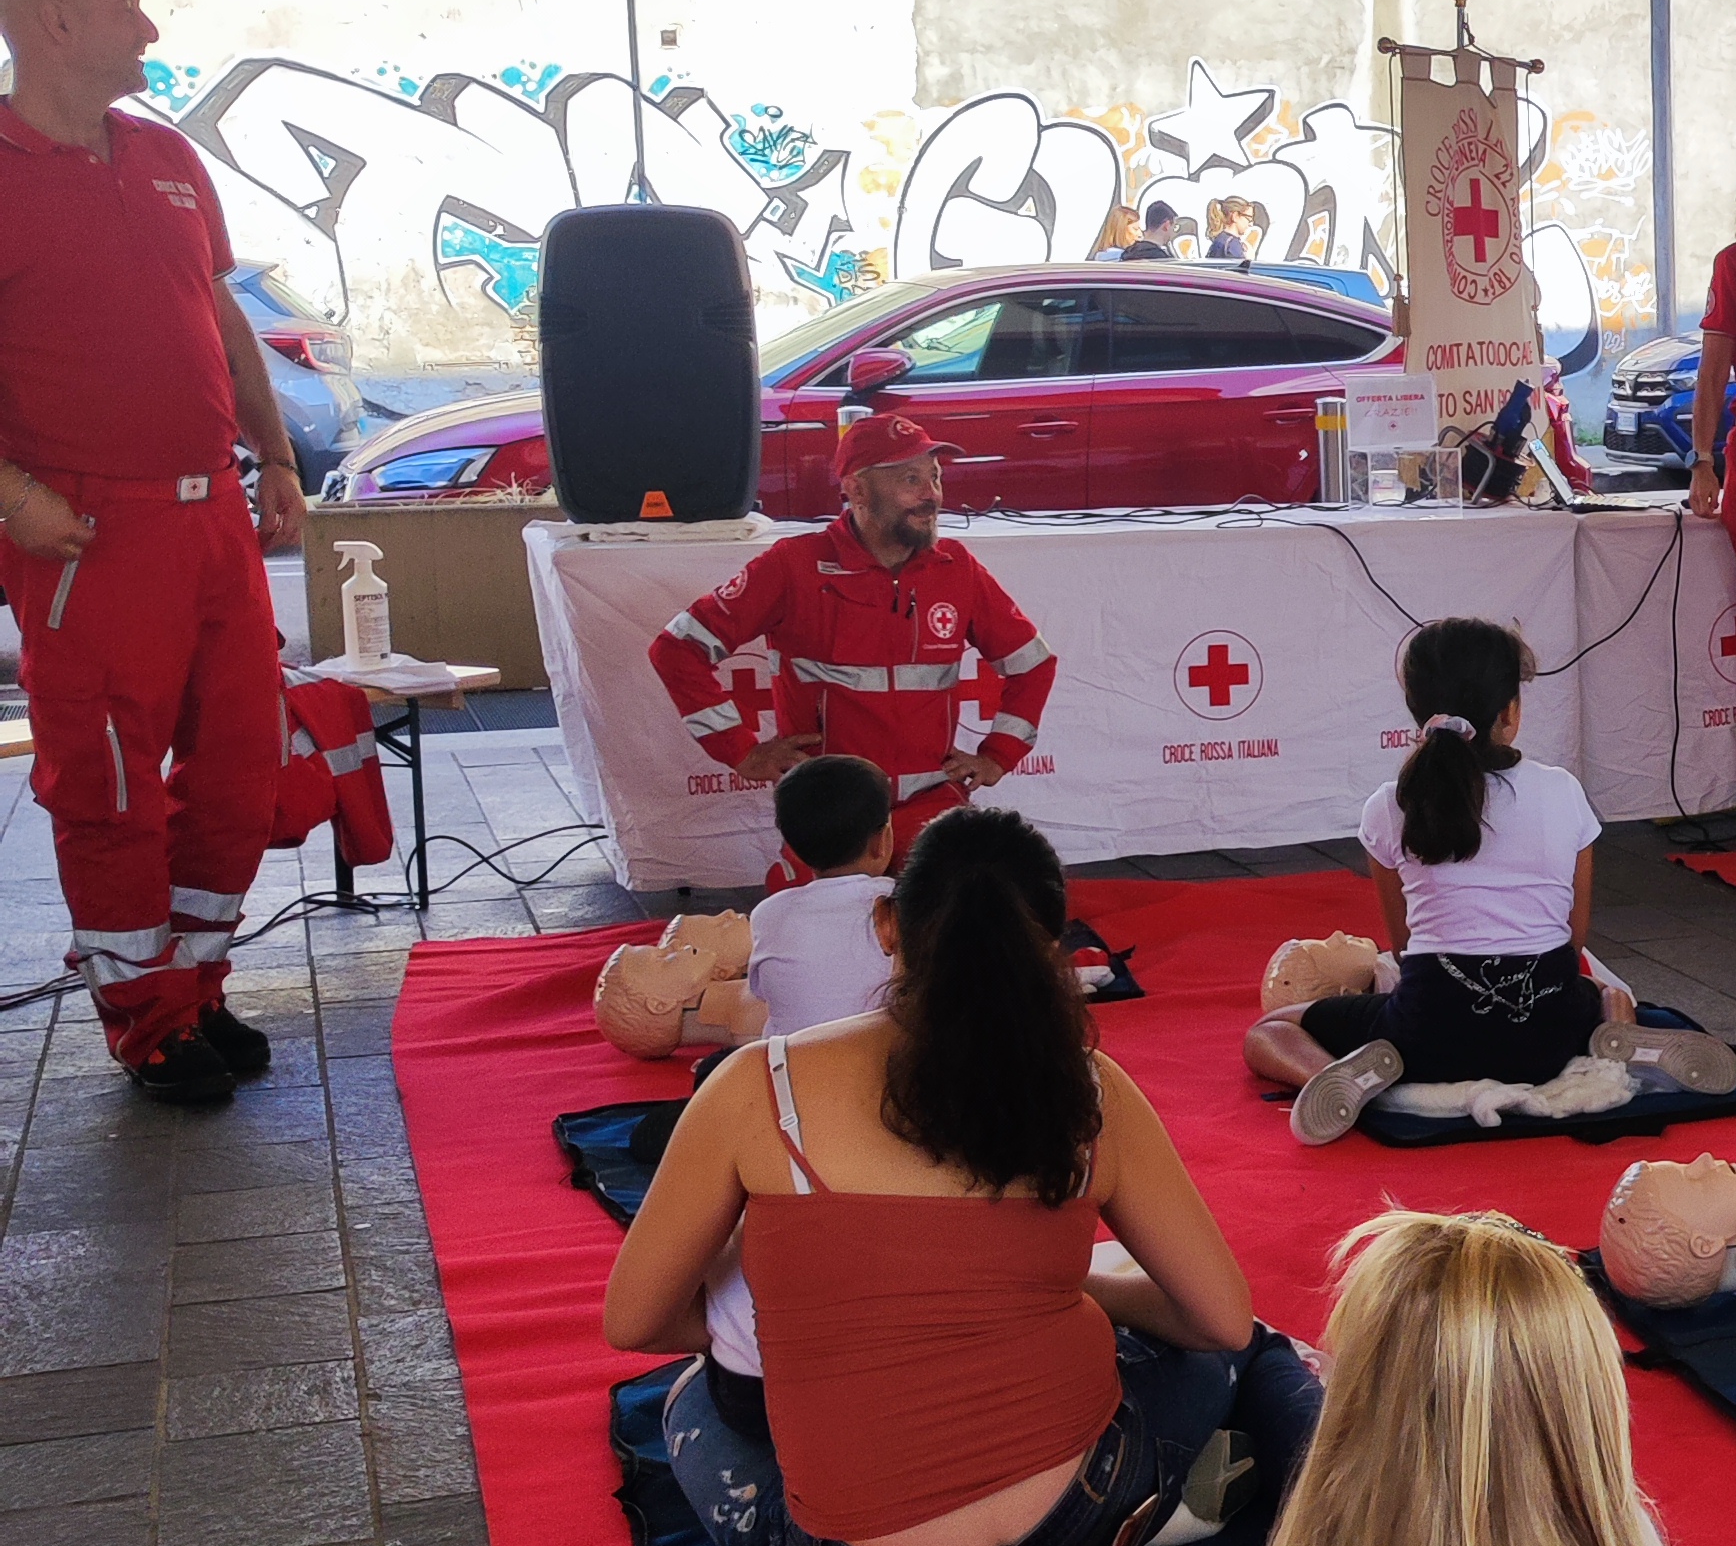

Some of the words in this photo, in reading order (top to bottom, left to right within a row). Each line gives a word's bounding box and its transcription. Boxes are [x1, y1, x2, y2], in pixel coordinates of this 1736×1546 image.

[1356, 394, 1393, 403] OFFERTA
[1395, 393, 1426, 402] LIBERA
[1463, 388, 1494, 416] SAN
[1702, 708, 1730, 728] CROCE
[1380, 729, 1411, 750] CROCE
[1162, 743, 1196, 765] CROCE
[1200, 741, 1234, 763] ROSSA
[1237, 738, 1280, 760] ITALIANA
[1012, 755, 1056, 776] TALIANA
[687, 773, 725, 796] CROCE
